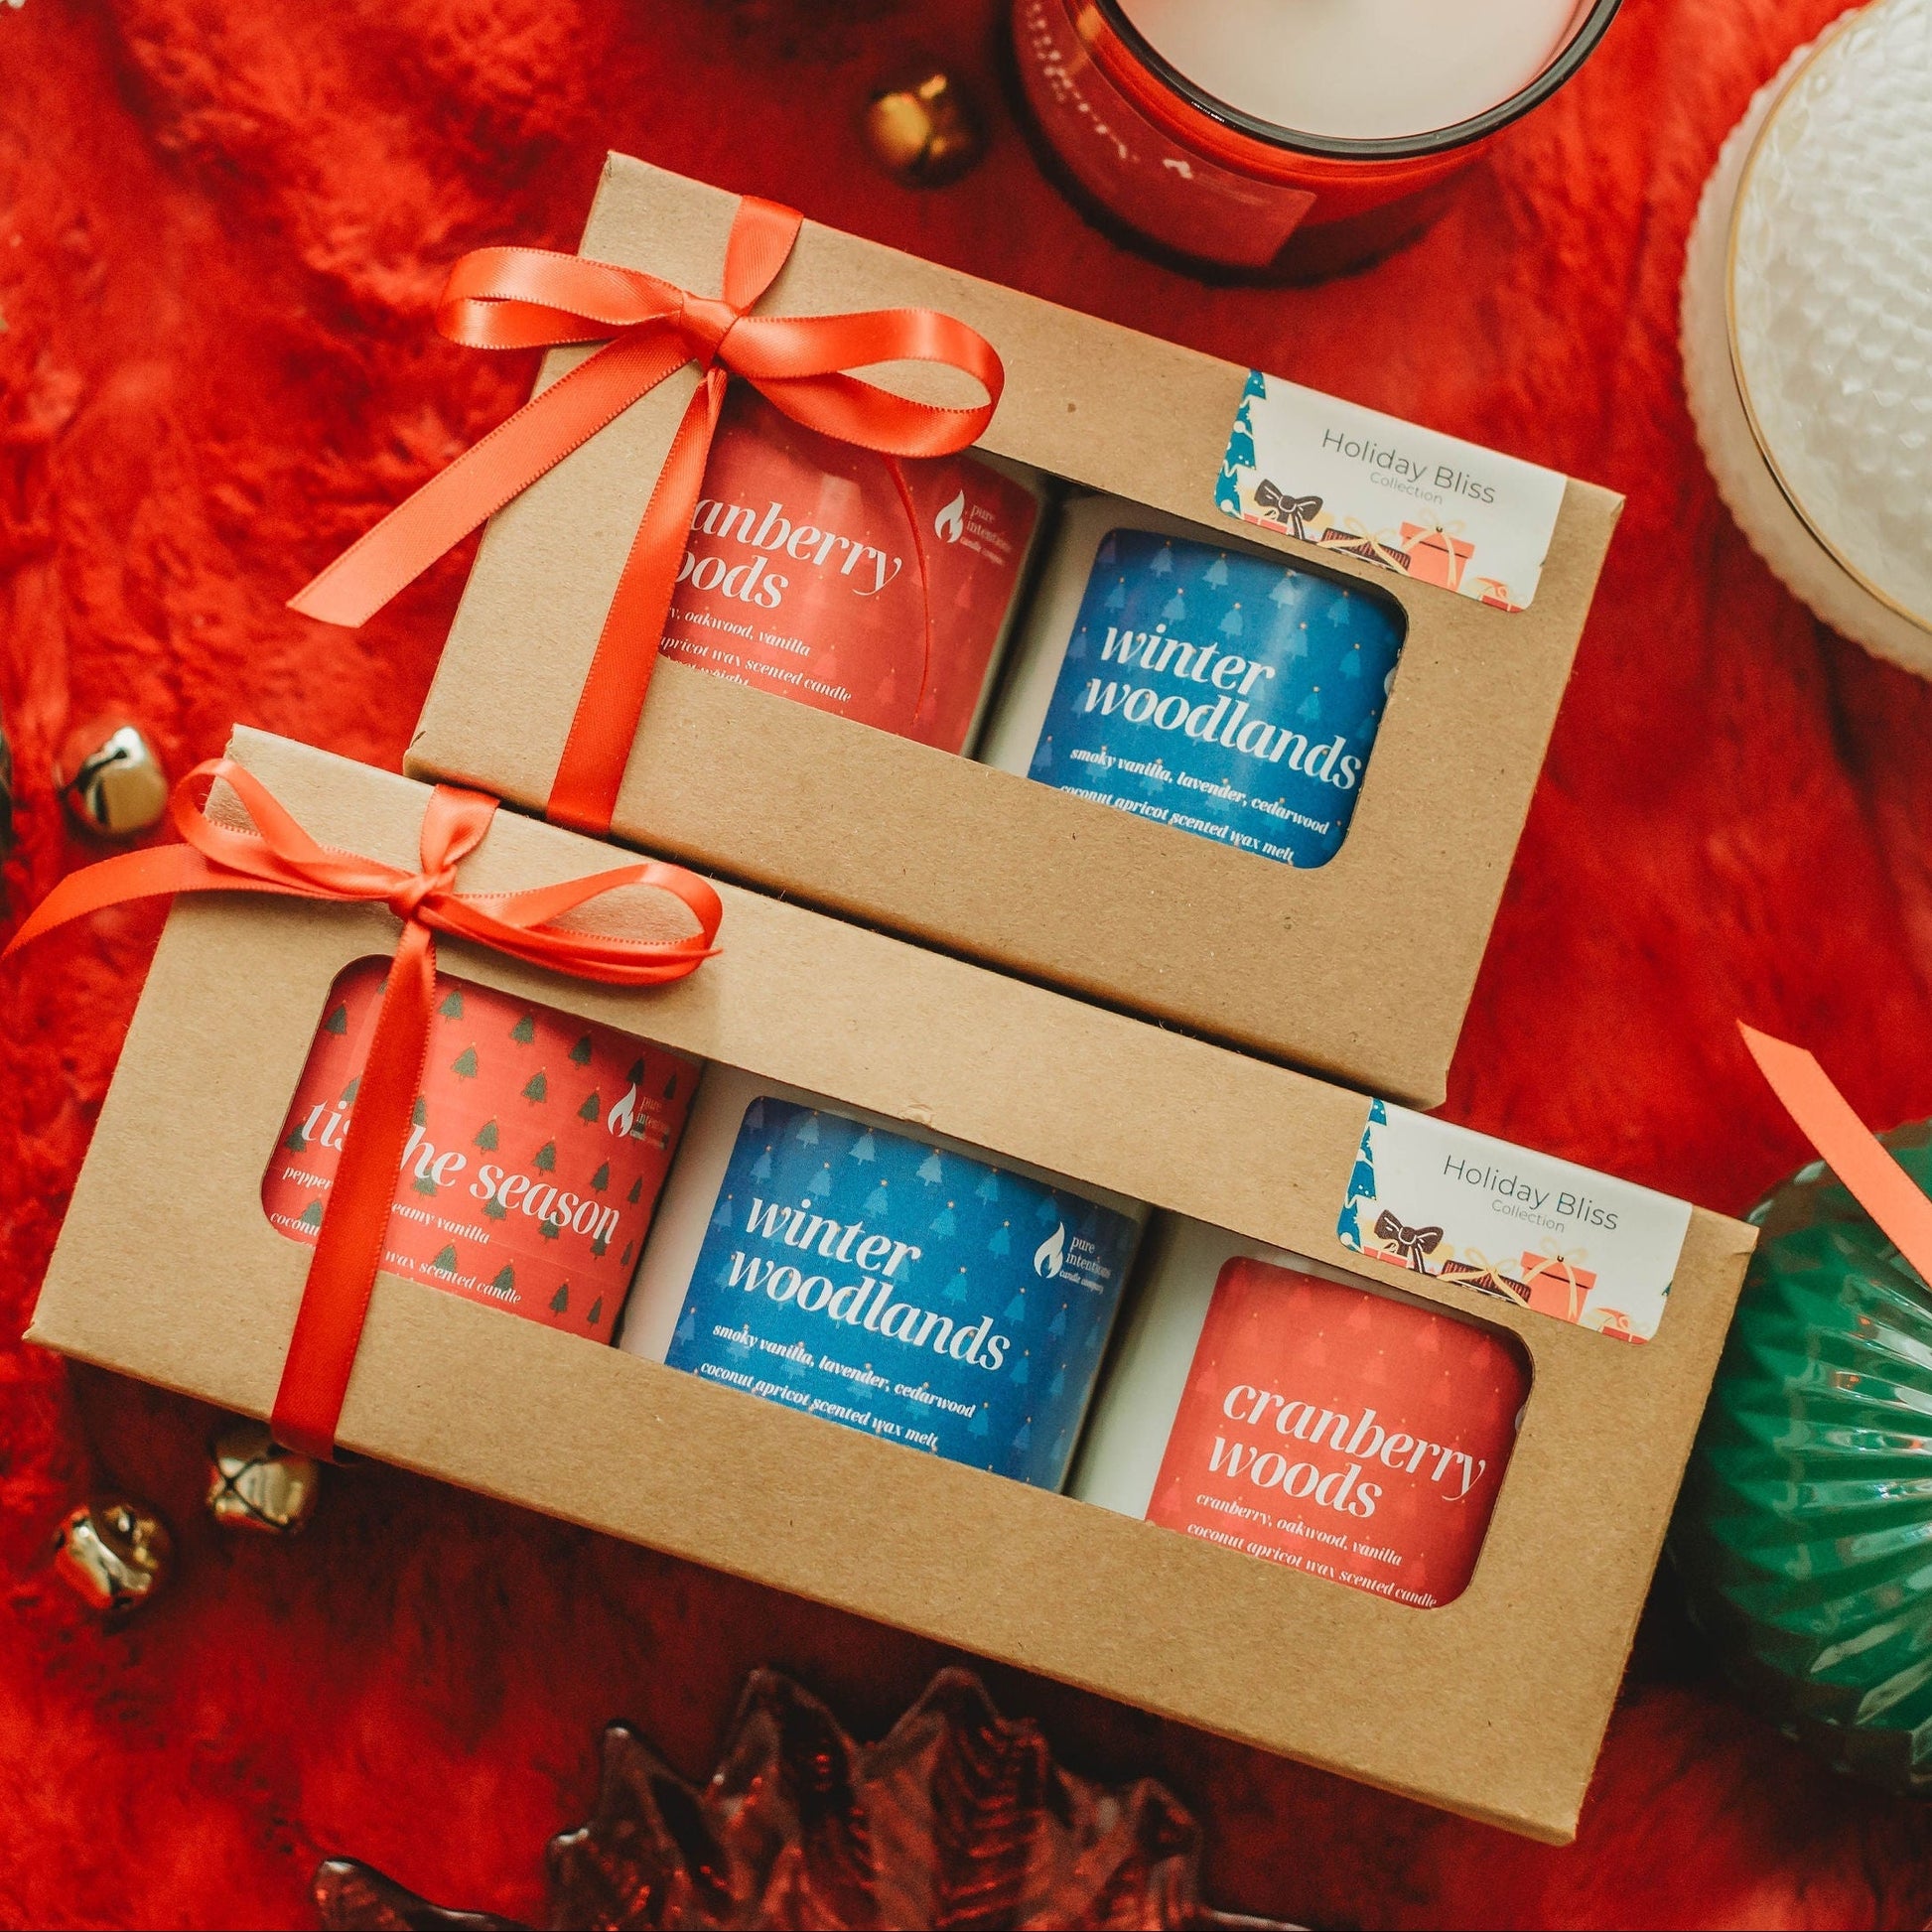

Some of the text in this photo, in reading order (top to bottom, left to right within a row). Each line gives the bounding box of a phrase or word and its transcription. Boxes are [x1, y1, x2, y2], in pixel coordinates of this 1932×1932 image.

[1322, 428, 1496, 504] Holiday Bliss
[1370, 472, 1444, 505] Collection
[675, 550, 789, 609] oods
[691, 498, 901, 596] anberry
[685, 611, 755, 639] oakwood,
[759, 631, 811, 656] vanilla
[1100, 623, 1275, 695] winter
[712, 648, 742, 667] wax
[746, 659, 803, 685] scented
[803, 678, 852, 702] candle
[1083, 678, 1362, 789] woodlands
[1060, 785, 1295, 862] coconut apricot scented wax melt
[1070, 748, 1330, 835] smoky vanilla, lavender, cedarwood
[391, 1202, 436, 1226] eamy
[437, 1217, 490, 1245] vanilla
[400, 1123, 468, 1187] he
[470, 1163, 621, 1245] season
[1443, 1154, 1619, 1230] Holiday Bliss
[1491, 1199, 1566, 1233] Collection
[270, 1212, 320, 1237] coconu
[385, 1251, 416, 1270] wax
[419, 1262, 477, 1290] scented
[477, 1282, 522, 1305] candle
[745, 1197, 922, 1278] winter
[1069, 1236, 1095, 1254] pure
[728, 1251, 1012, 1371] woodlands
[700, 1361, 939, 1449] coconut apricot scented wax melt
[712, 1323, 977, 1420] smoky vanilla, lavender, cedarwood
[1207, 1436, 1384, 1519] woods
[1223, 1384, 1486, 1502] cranberry
[1186, 1522, 1438, 1607] coconut apricot wax scented candle
[1195, 1493, 1403, 1567] cranberry, oakwood, vanilla
